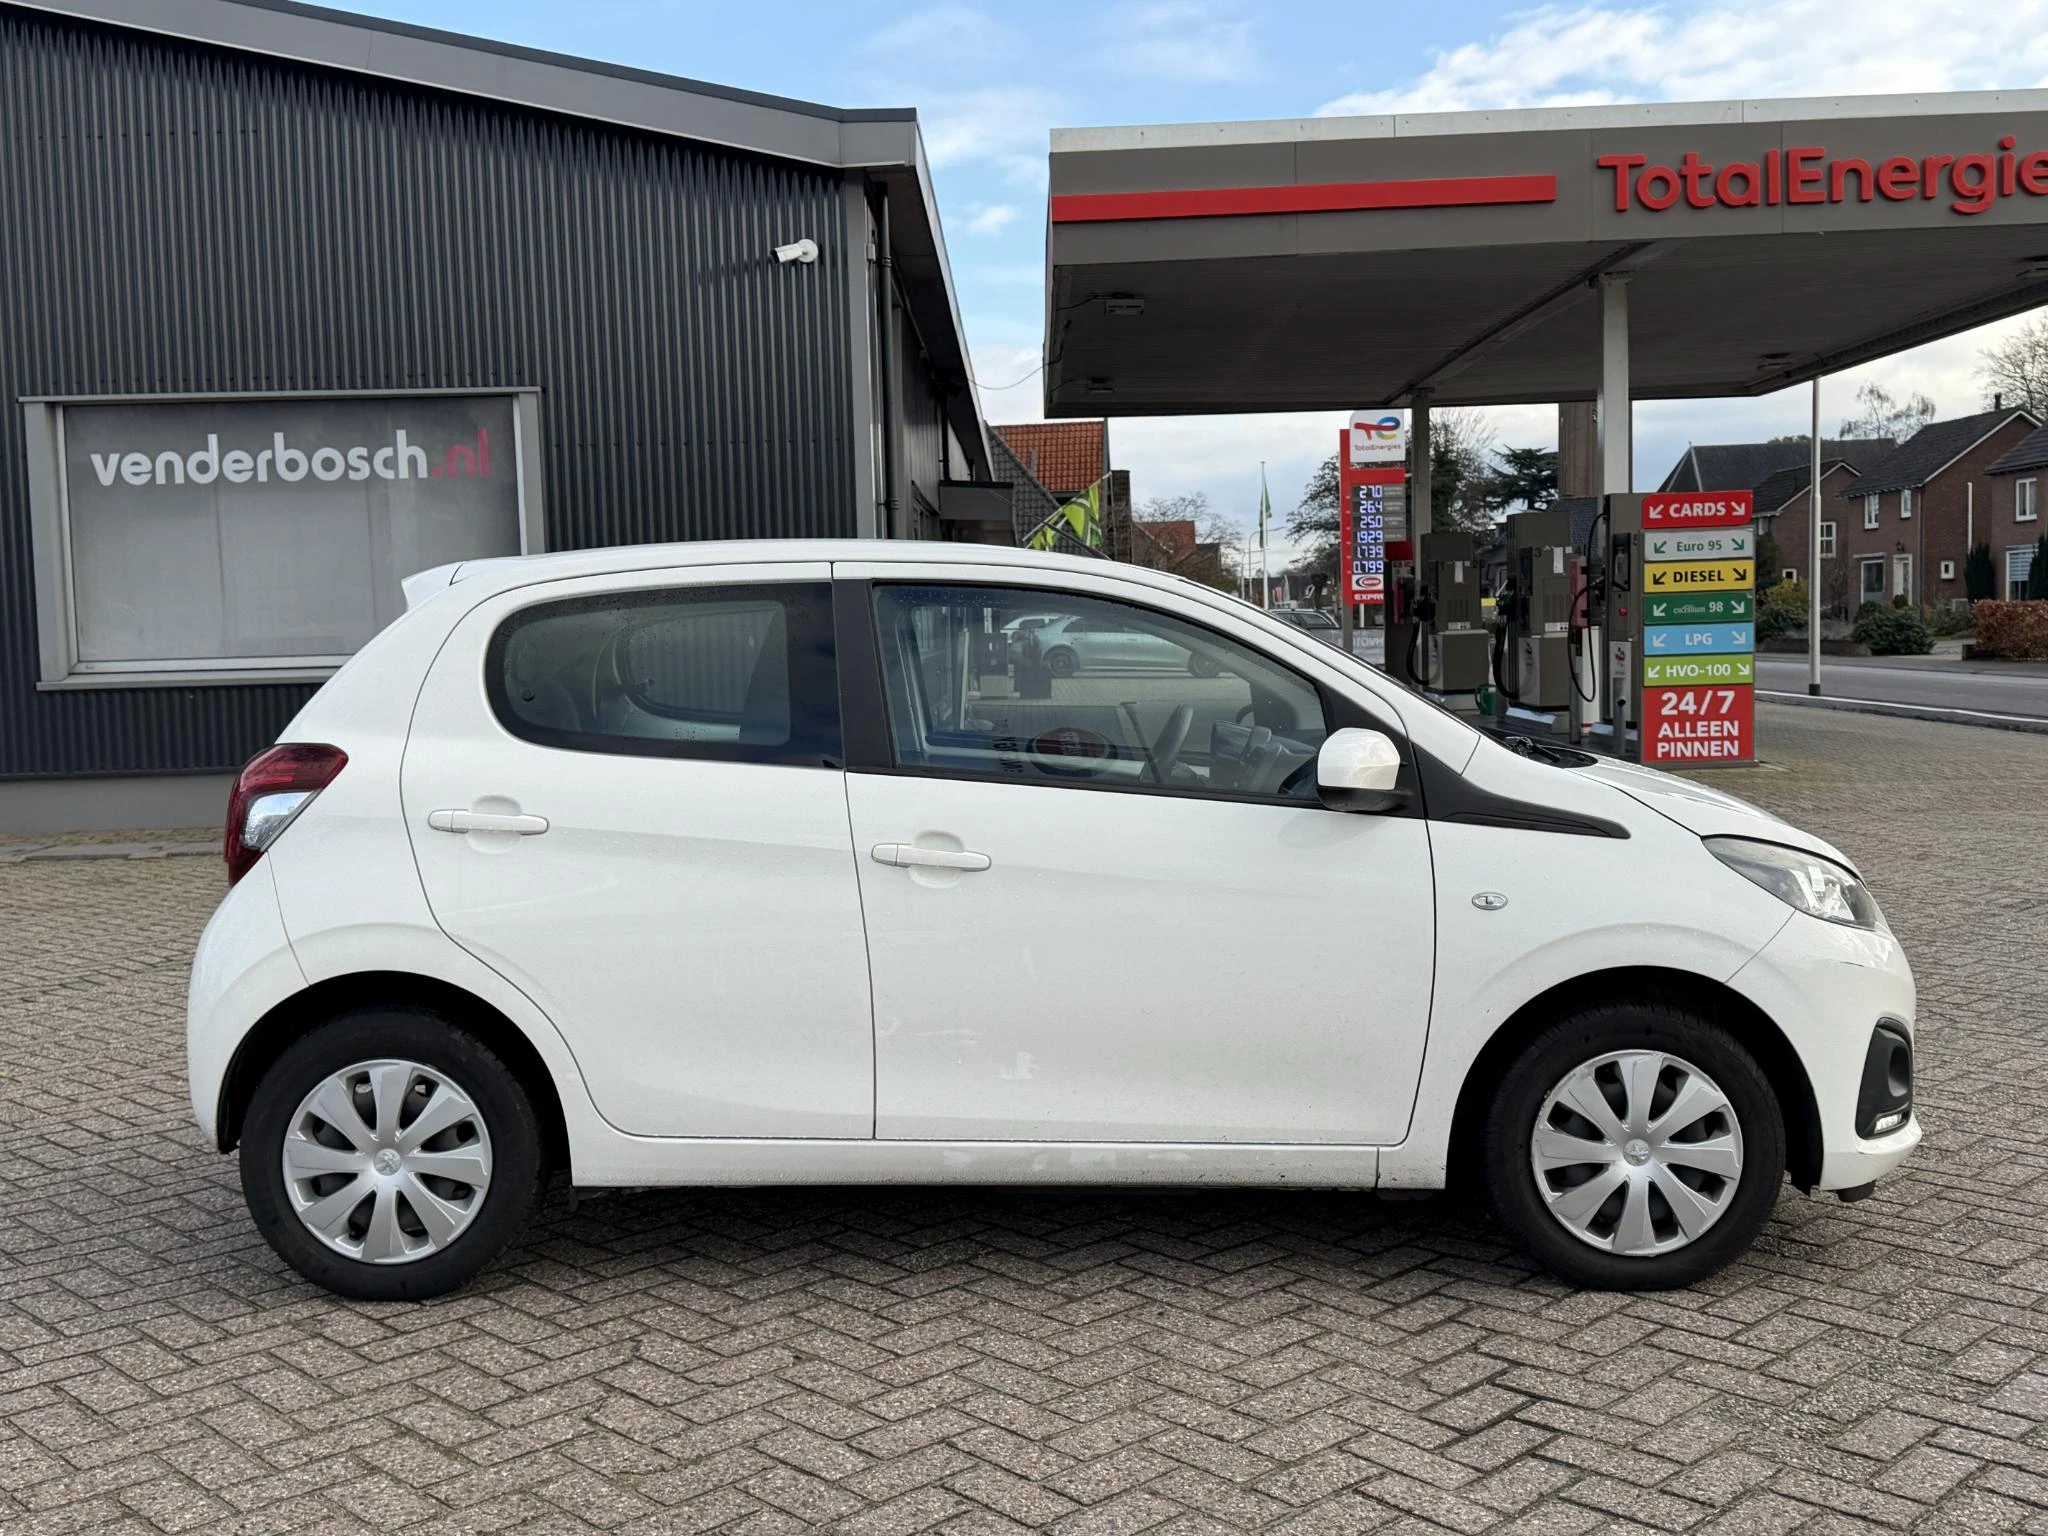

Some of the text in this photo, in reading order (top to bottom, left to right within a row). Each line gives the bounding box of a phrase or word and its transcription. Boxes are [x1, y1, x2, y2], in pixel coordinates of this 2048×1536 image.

[90, 427, 490, 486] venderbosch.nl
[1669, 502, 1726, 518] CARDS
[1534, 547, 1542, 557] 3
[1676, 540, 1722, 552] Euro 95
[1673, 570, 1725, 583] DIESEL
[1708, 601, 1724, 613] 98
[1685, 633, 1713, 646] LPG
[1666, 664, 1731, 677] HVO-100
[1661, 690, 1735, 715] 24/7
[1658, 720, 1739, 738] ALLEEN
[1657, 740, 1739, 758] PINNEN
